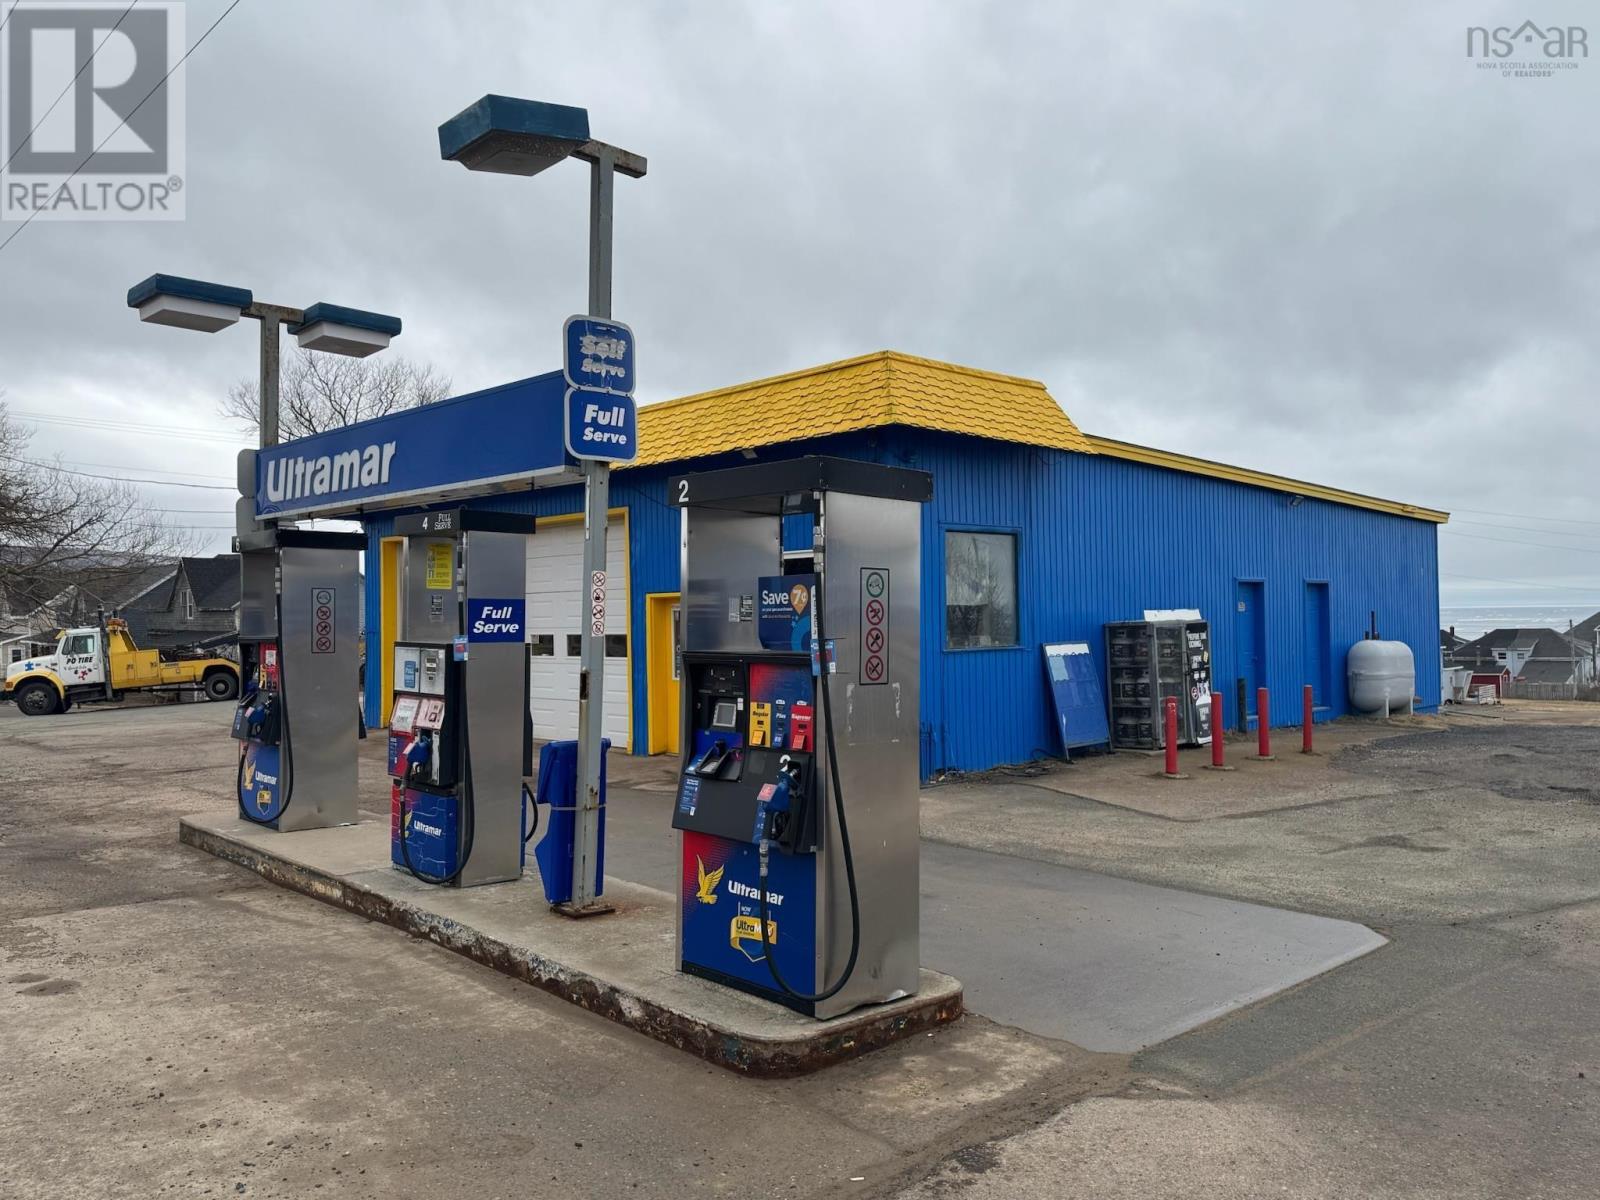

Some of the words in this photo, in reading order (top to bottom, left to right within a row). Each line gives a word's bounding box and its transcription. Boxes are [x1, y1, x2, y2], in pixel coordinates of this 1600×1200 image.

[584, 403, 626, 427] Full
[582, 427, 628, 445] Serve
[266, 440, 397, 503] Ultramar
[678, 479, 690, 503] 2
[422, 517, 428, 530] 4
[438, 513, 451, 522] FULL
[761, 590, 789, 605] Save
[481, 606, 513, 619] Full
[472, 620, 519, 633] Serve
[413, 820, 442, 838] Ultramar
